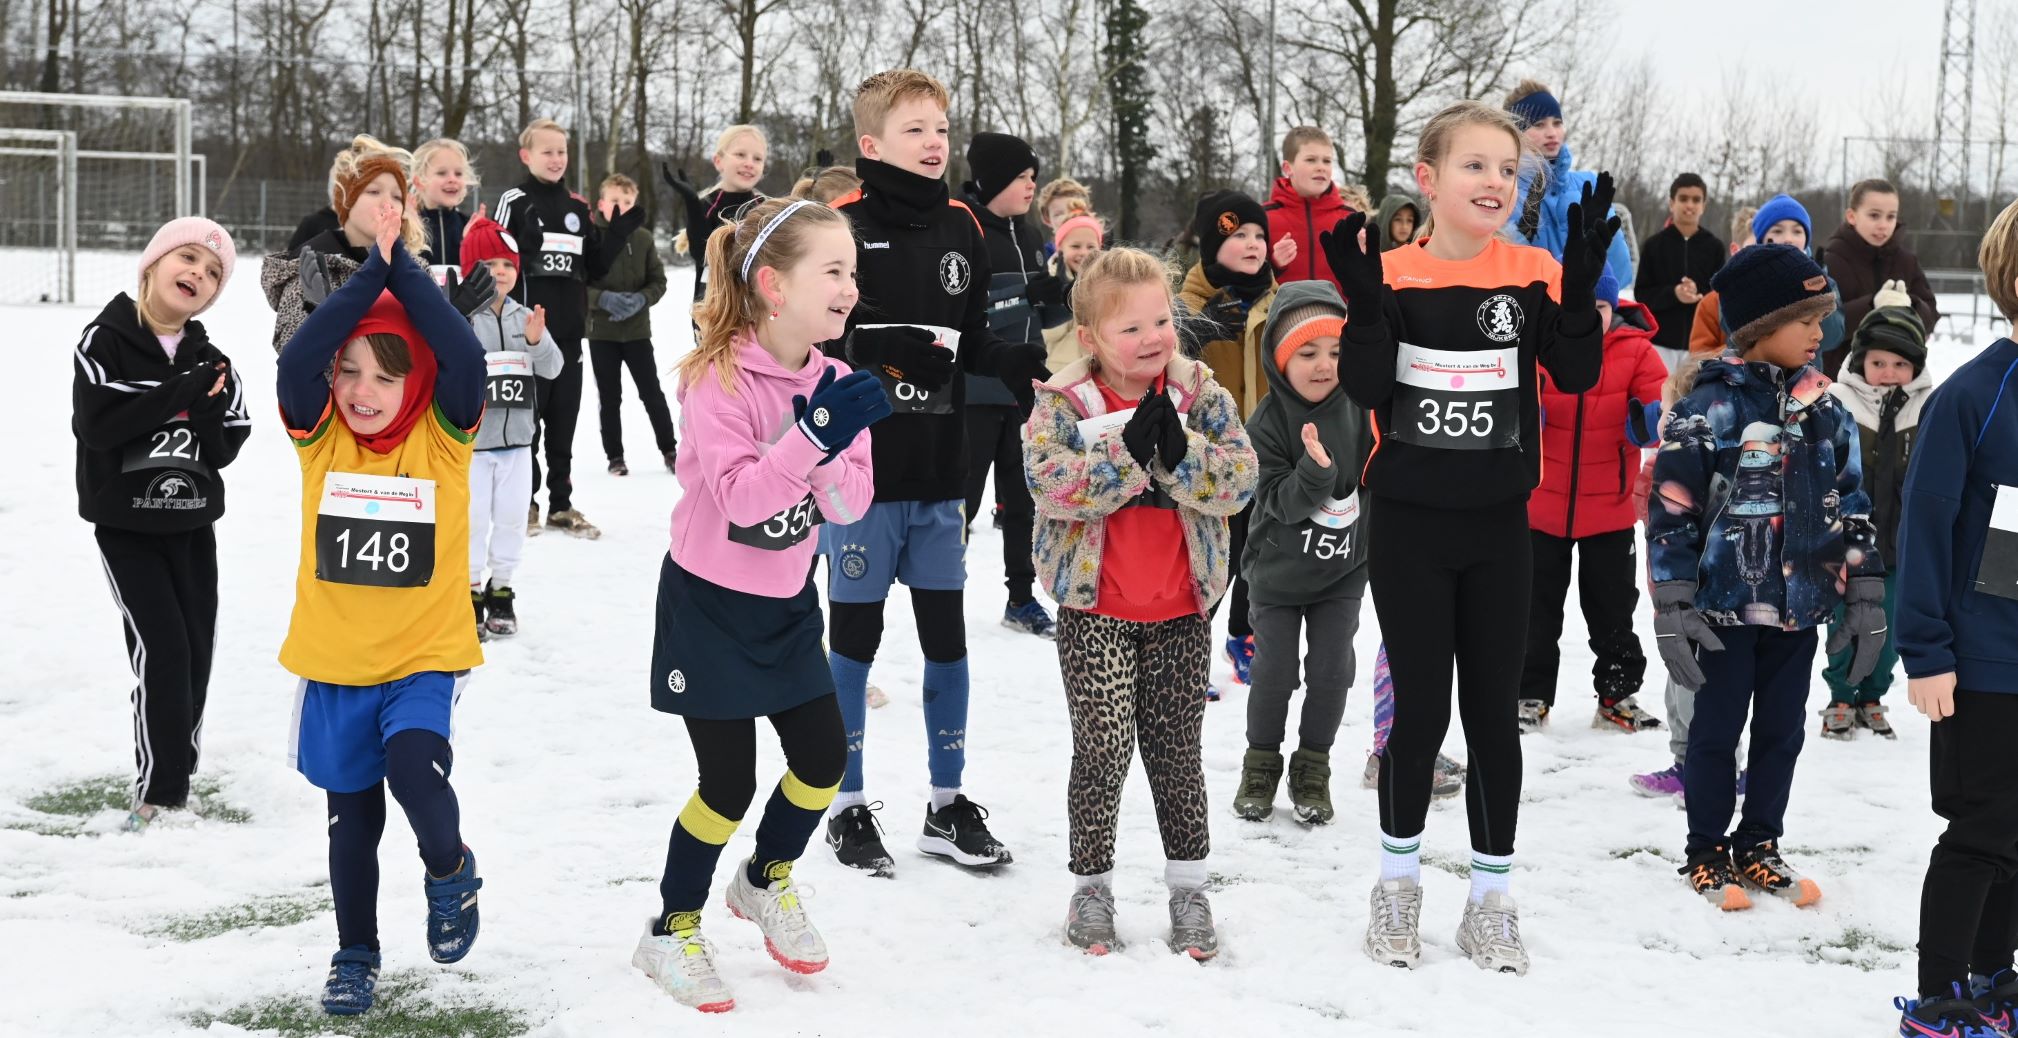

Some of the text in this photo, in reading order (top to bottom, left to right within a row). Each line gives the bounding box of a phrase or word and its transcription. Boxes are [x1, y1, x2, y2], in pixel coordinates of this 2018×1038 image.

[863, 240, 890, 250] hummel
[543, 253, 573, 272] 332
[487, 379, 524, 402] 152
[1417, 398, 1494, 437] 355
[132, 497, 207, 510] PANTHERS
[763, 494, 816, 538] 356
[336, 528, 410, 573] 148
[1301, 528, 1351, 560] 154
